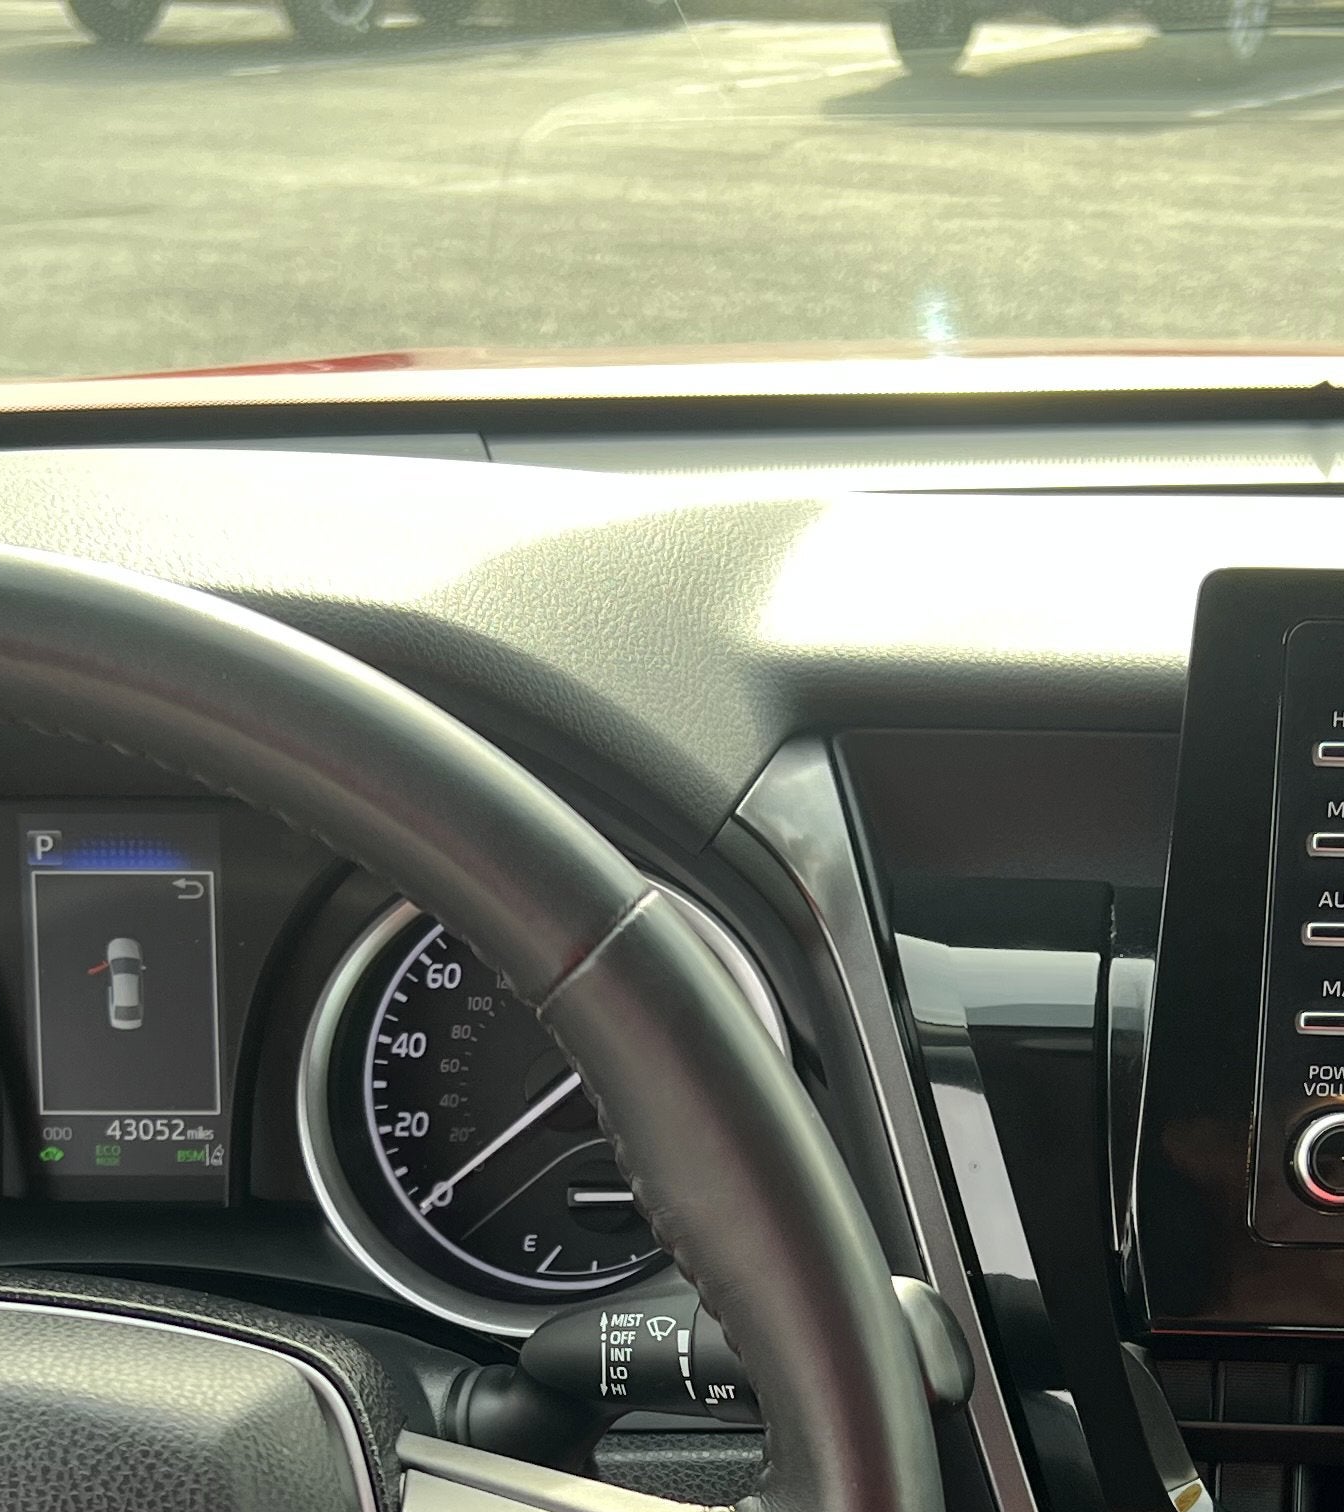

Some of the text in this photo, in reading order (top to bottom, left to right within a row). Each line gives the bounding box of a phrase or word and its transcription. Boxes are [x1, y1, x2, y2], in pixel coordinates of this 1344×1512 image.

[35, 835, 54, 860] P
[426, 962, 462, 989] 60
[467, 996, 493, 1011] 100
[451, 1025, 471, 1039] 80
[391, 1031, 427, 1059] 40
[439, 1058, 460, 1073] 60
[439, 1094, 459, 1108] 40
[43, 1127, 73, 1141] ODO
[106, 1119, 186, 1141] 43052
[394, 1110, 430, 1138] 20
[96, 1145, 122, 1156] ECO
[523, 1234, 537, 1252] E
[610, 1313, 644, 1327] MIST
[610, 1331, 636, 1345] OFF
[610, 1347, 633, 1362] INT
[609, 1366, 628, 1380] LO
[611, 1383, 627, 1396] HI
[708, 1384, 736, 1400] INT
